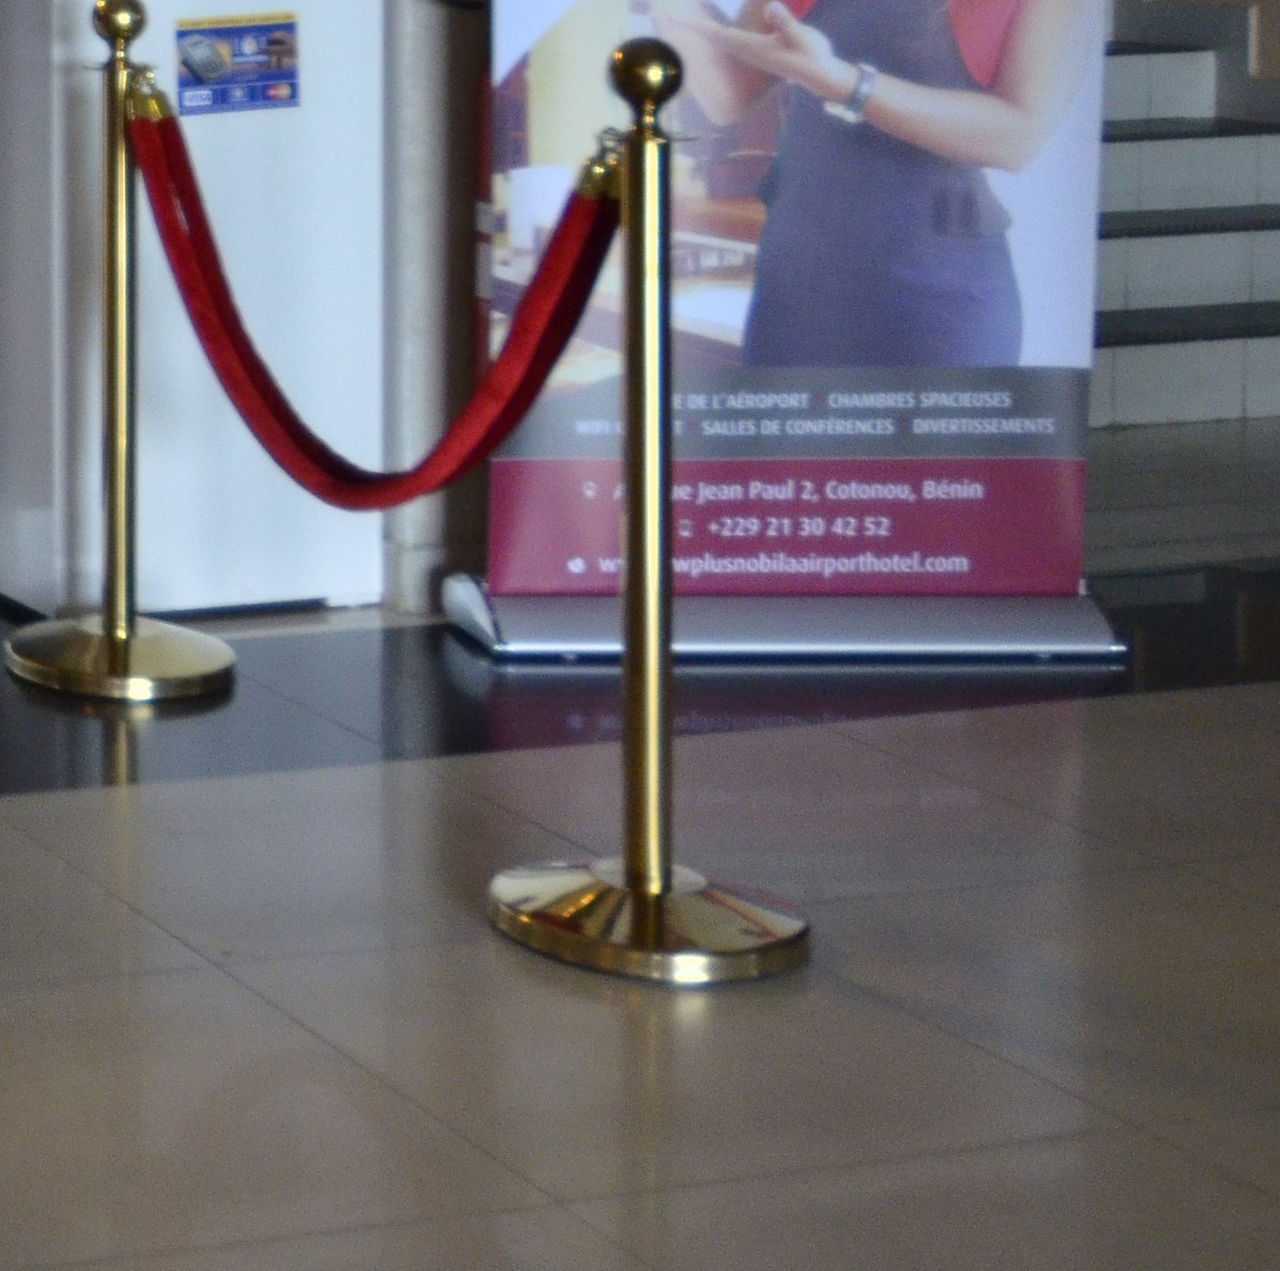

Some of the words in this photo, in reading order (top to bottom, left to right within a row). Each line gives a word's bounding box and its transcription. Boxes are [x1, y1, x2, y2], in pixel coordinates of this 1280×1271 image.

[687, 393, 708, 410] DE
[828, 391, 916, 408] CHAMBRES
[919, 390, 1012, 408] SPACIEUSES
[701, 420, 755, 436] SALLES
[760, 420, 781, 435] DE
[696, 481, 744, 505] Jean
[748, 479, 796, 501] Paul
[922, 478, 985, 500] Bénin
[707, 516, 761, 538] +229
[766, 516, 791, 538] 21
[797, 516, 826, 537] 30
[831, 516, 858, 537] 42
[863, 516, 891, 537] 52
